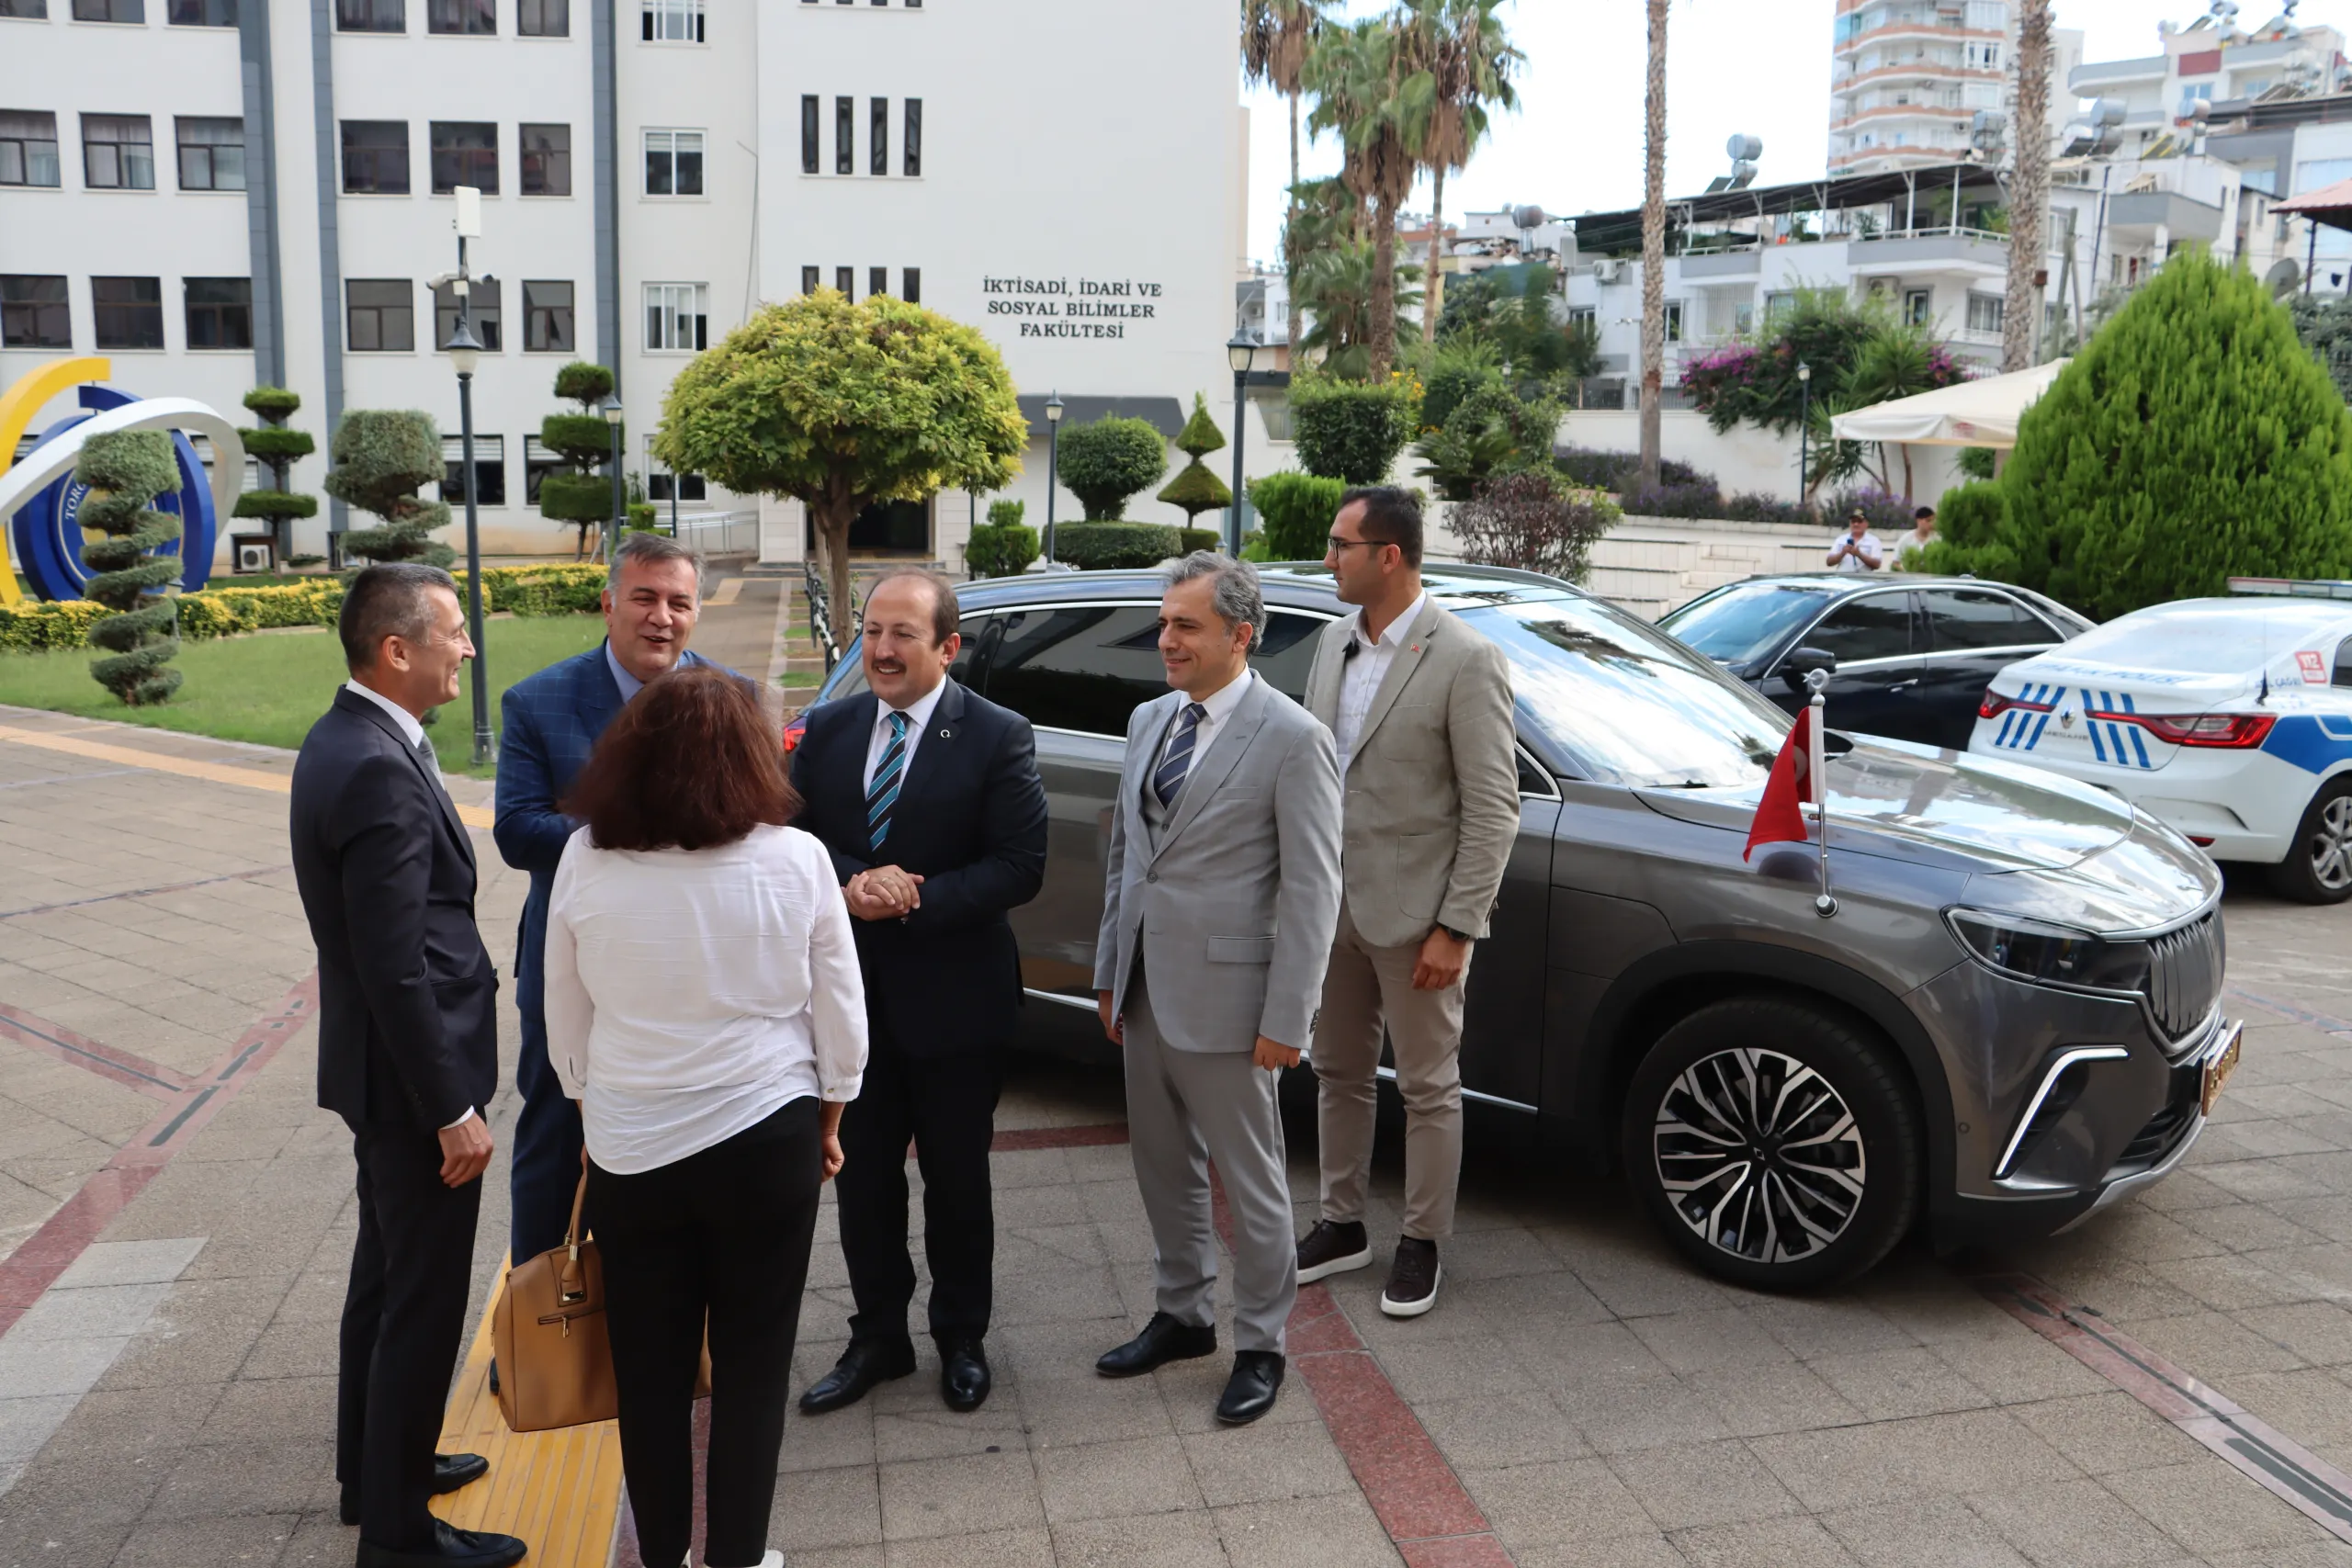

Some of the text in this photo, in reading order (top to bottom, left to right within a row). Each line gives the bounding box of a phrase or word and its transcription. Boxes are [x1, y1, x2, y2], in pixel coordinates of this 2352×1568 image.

[983, 276, 1162, 298] İKTİSADİ, İDARİ VE
[988, 299, 1155, 318] SOSYAL BİLİMLER
[1020, 320, 1125, 338] FAKÜLTESİ
